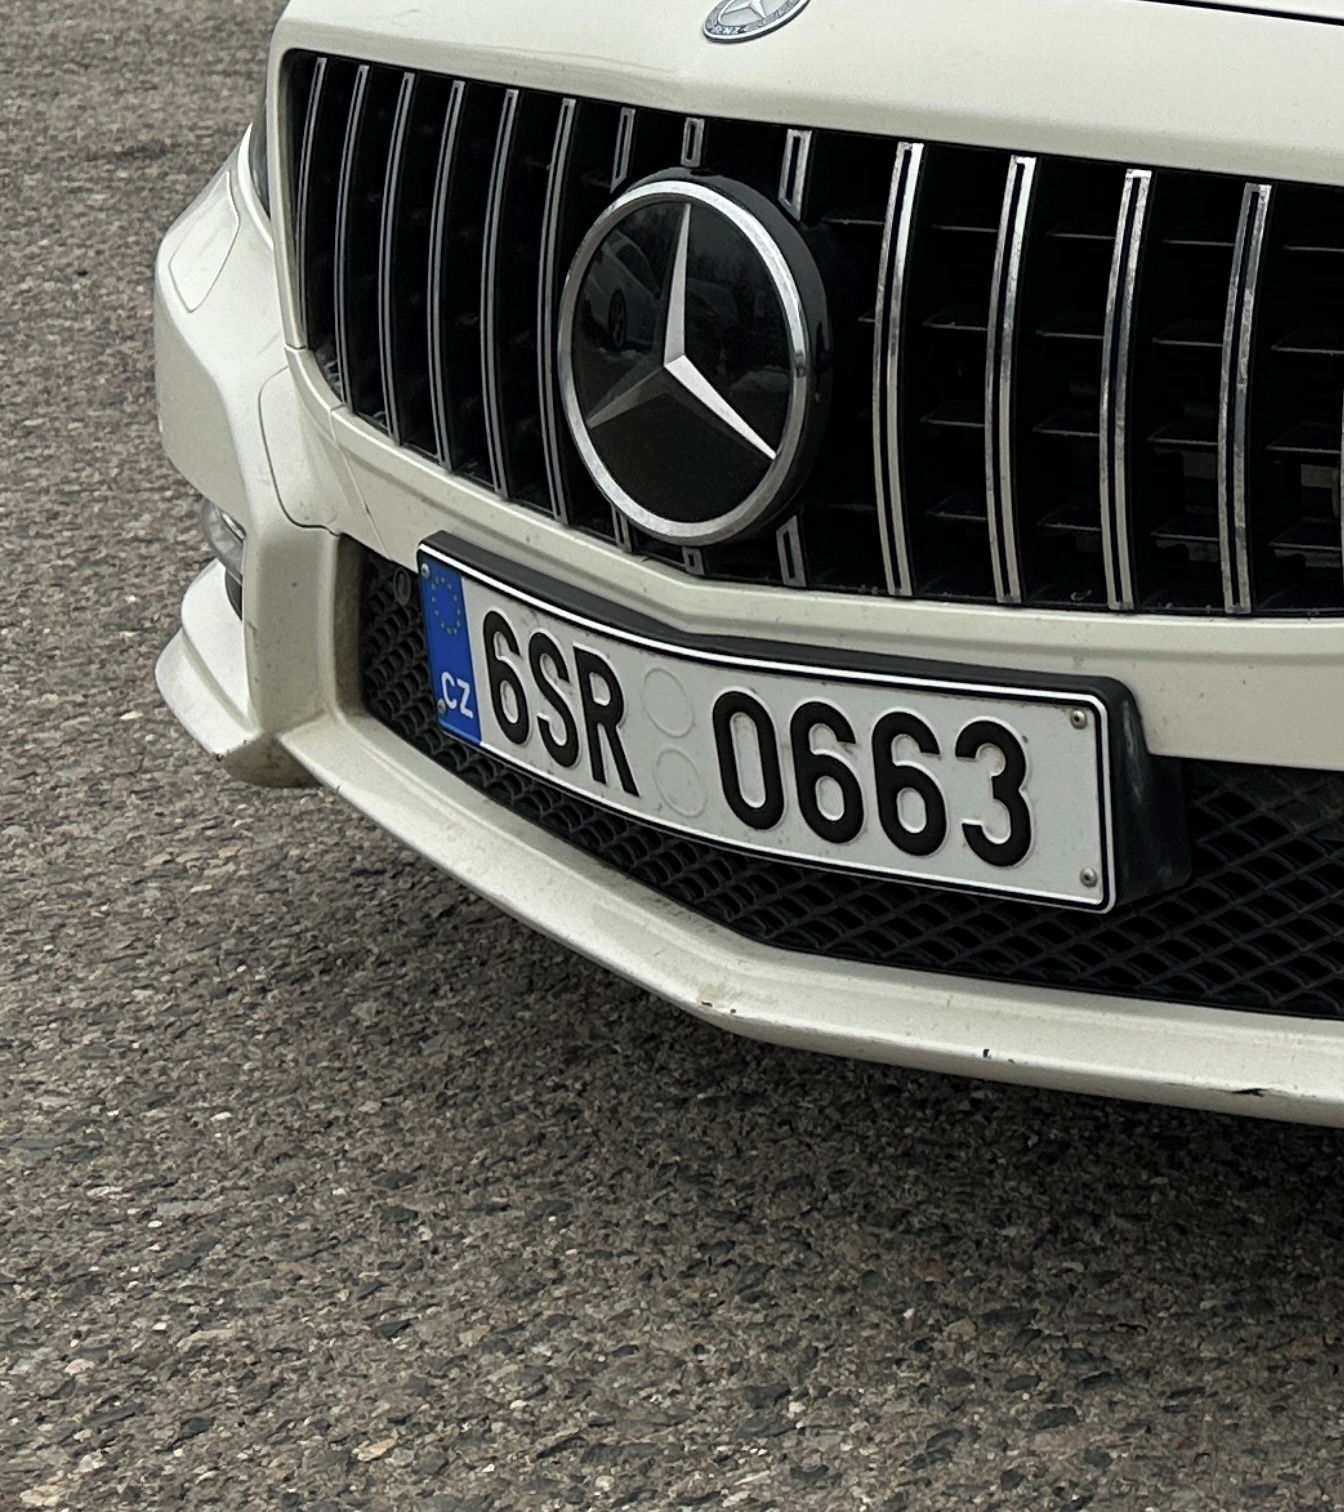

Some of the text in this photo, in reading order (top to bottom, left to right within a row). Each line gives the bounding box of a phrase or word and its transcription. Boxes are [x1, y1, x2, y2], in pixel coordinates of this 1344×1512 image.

[441, 671, 474, 719] CZ
[482, 610, 1032, 867] 6SR 0663
